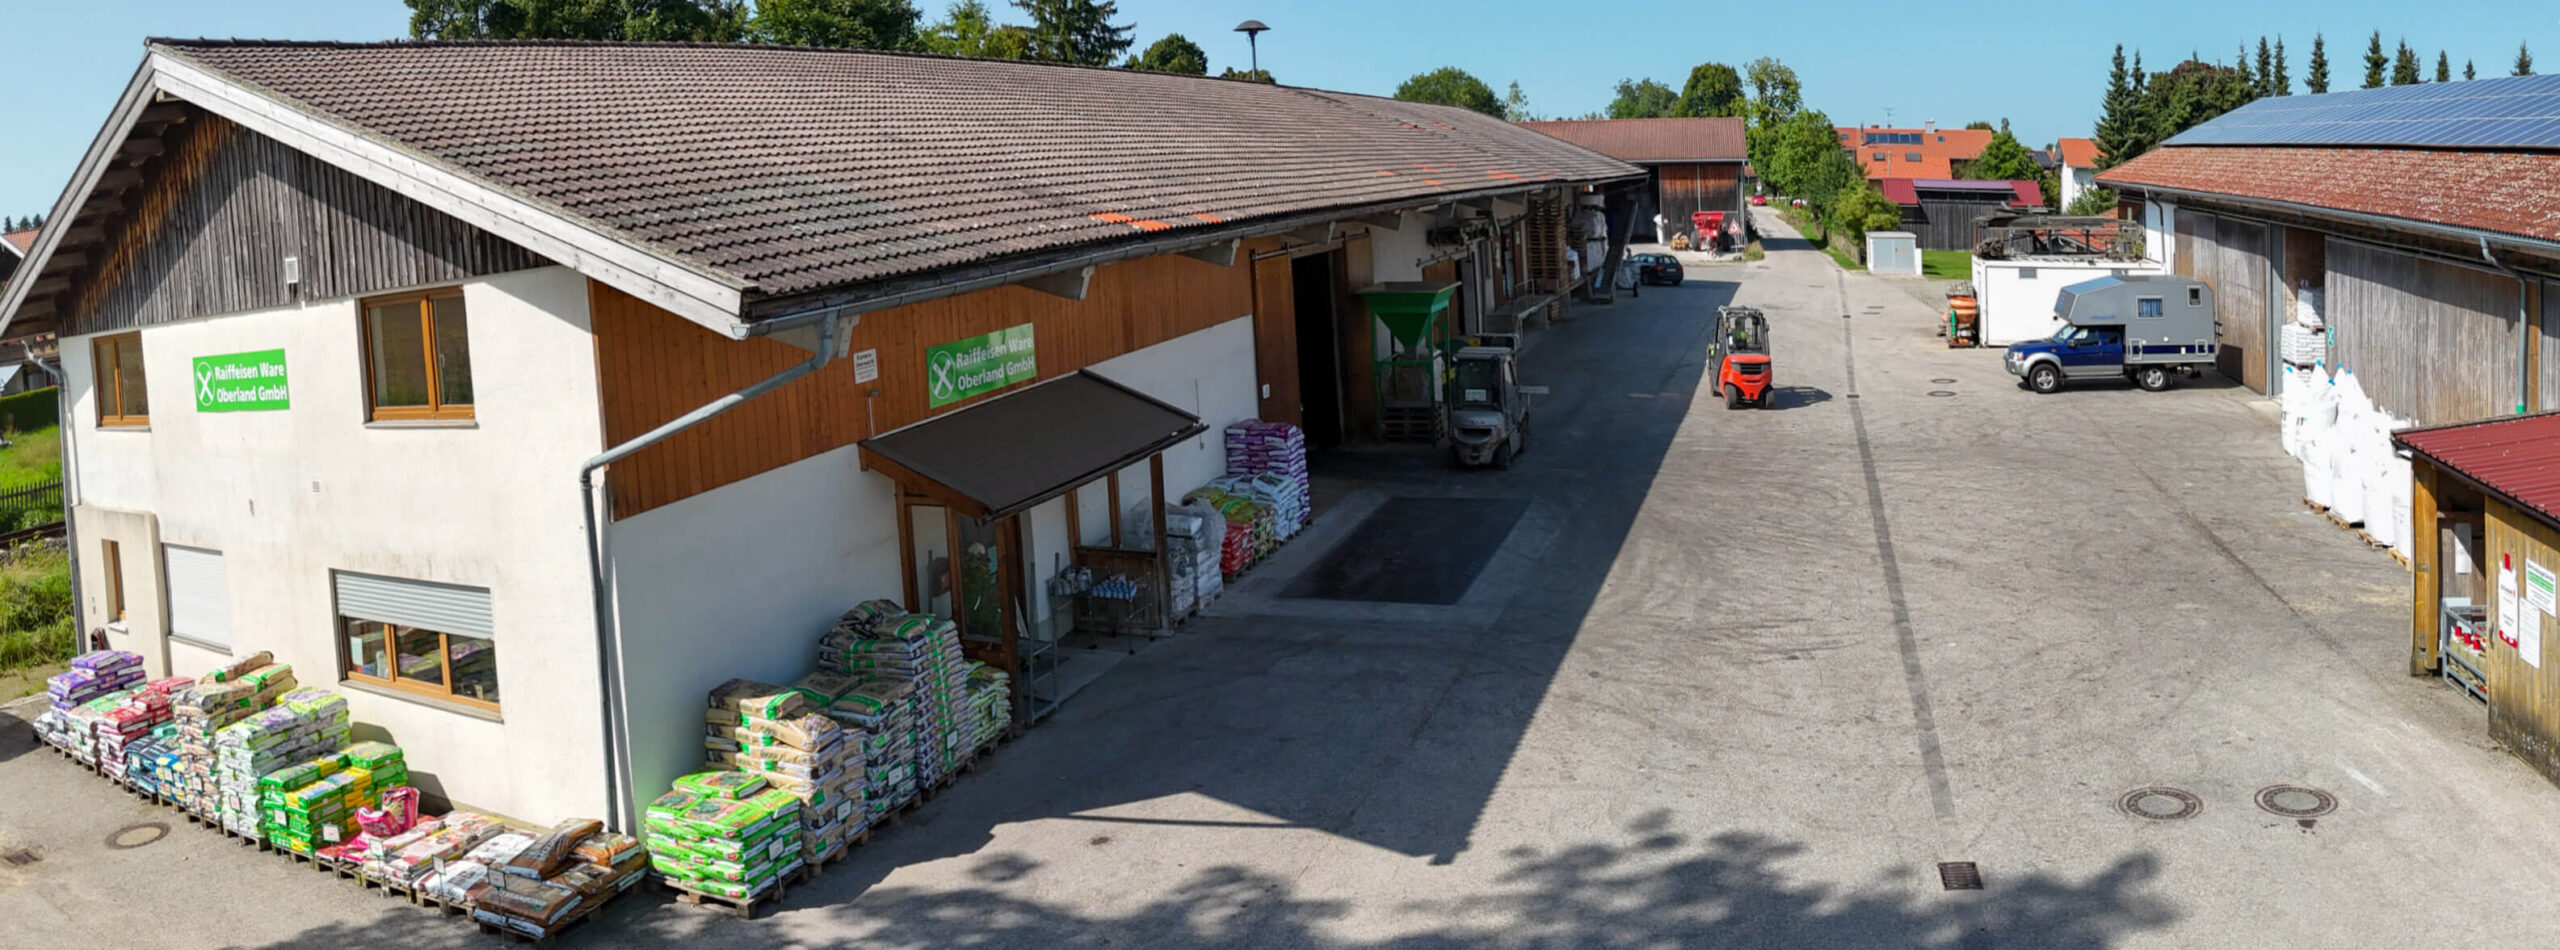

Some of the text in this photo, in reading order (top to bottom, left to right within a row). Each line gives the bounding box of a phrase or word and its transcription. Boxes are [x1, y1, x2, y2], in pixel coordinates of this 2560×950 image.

[956, 337, 1033, 369] Raiffeisen Ware
[214, 362, 285, 380] Raiffeisen Ware
[958, 355, 1035, 391] Oberland GmbH
[216, 384, 288, 403] Oberland GmbH
